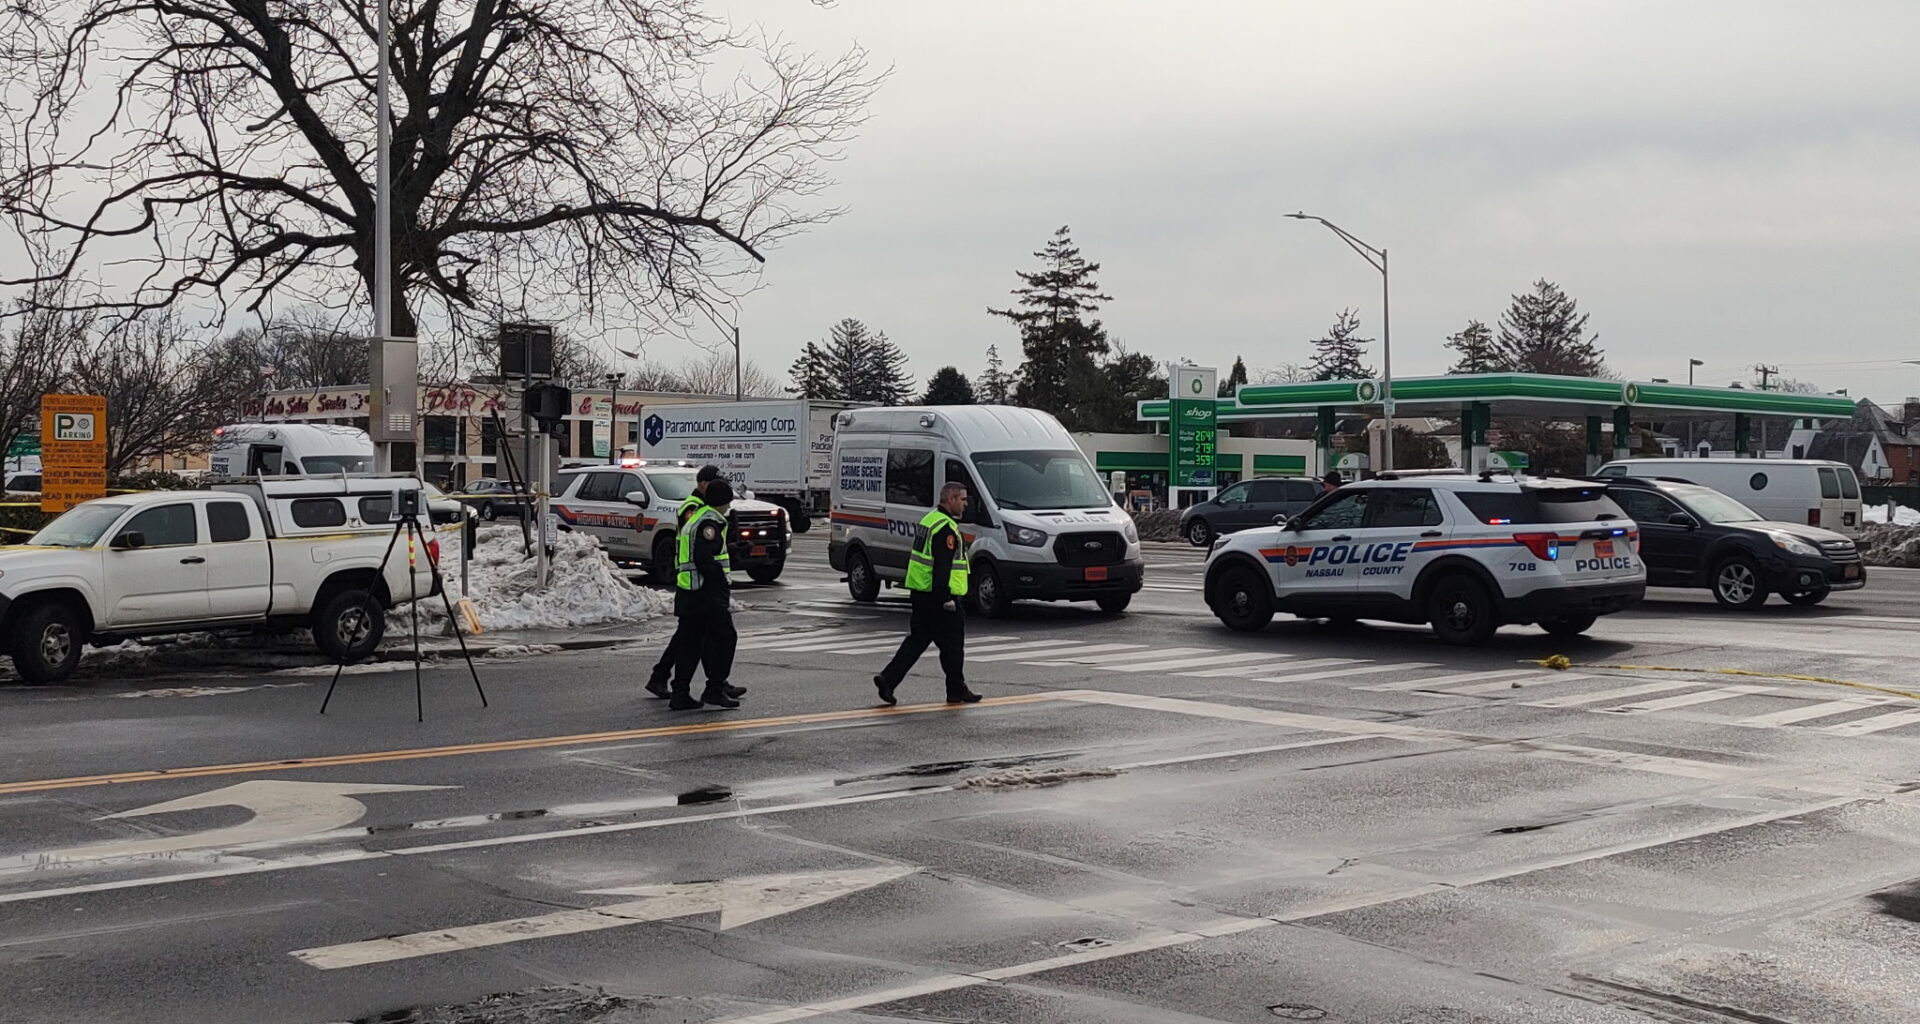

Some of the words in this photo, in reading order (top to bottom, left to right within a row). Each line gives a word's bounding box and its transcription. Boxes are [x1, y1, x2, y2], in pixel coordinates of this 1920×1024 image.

[1185, 407, 1212, 419] shop
[665, 419, 716, 434] Paramount
[719, 418, 767, 434] Packaging
[771, 417, 797, 433] Corp.
[862, 456, 883, 464] COUNTY
[841, 465, 861, 477] CRIME
[861, 466, 882, 478] SCENE
[840, 479, 865, 491] SEARCH
[866, 480, 882, 492] UNIT
[576, 513, 605, 526] HIGHWAY
[607, 516, 631, 528] PATROL
[1052, 515, 1110, 524] POLICE
[1308, 542, 1413, 566] POLICE
[1508, 562, 1536, 571] 708
[1575, 557, 1631, 572] POLICE
[1305, 567, 1344, 578] NASSAU
[1363, 565, 1404, 576] COUNTY
